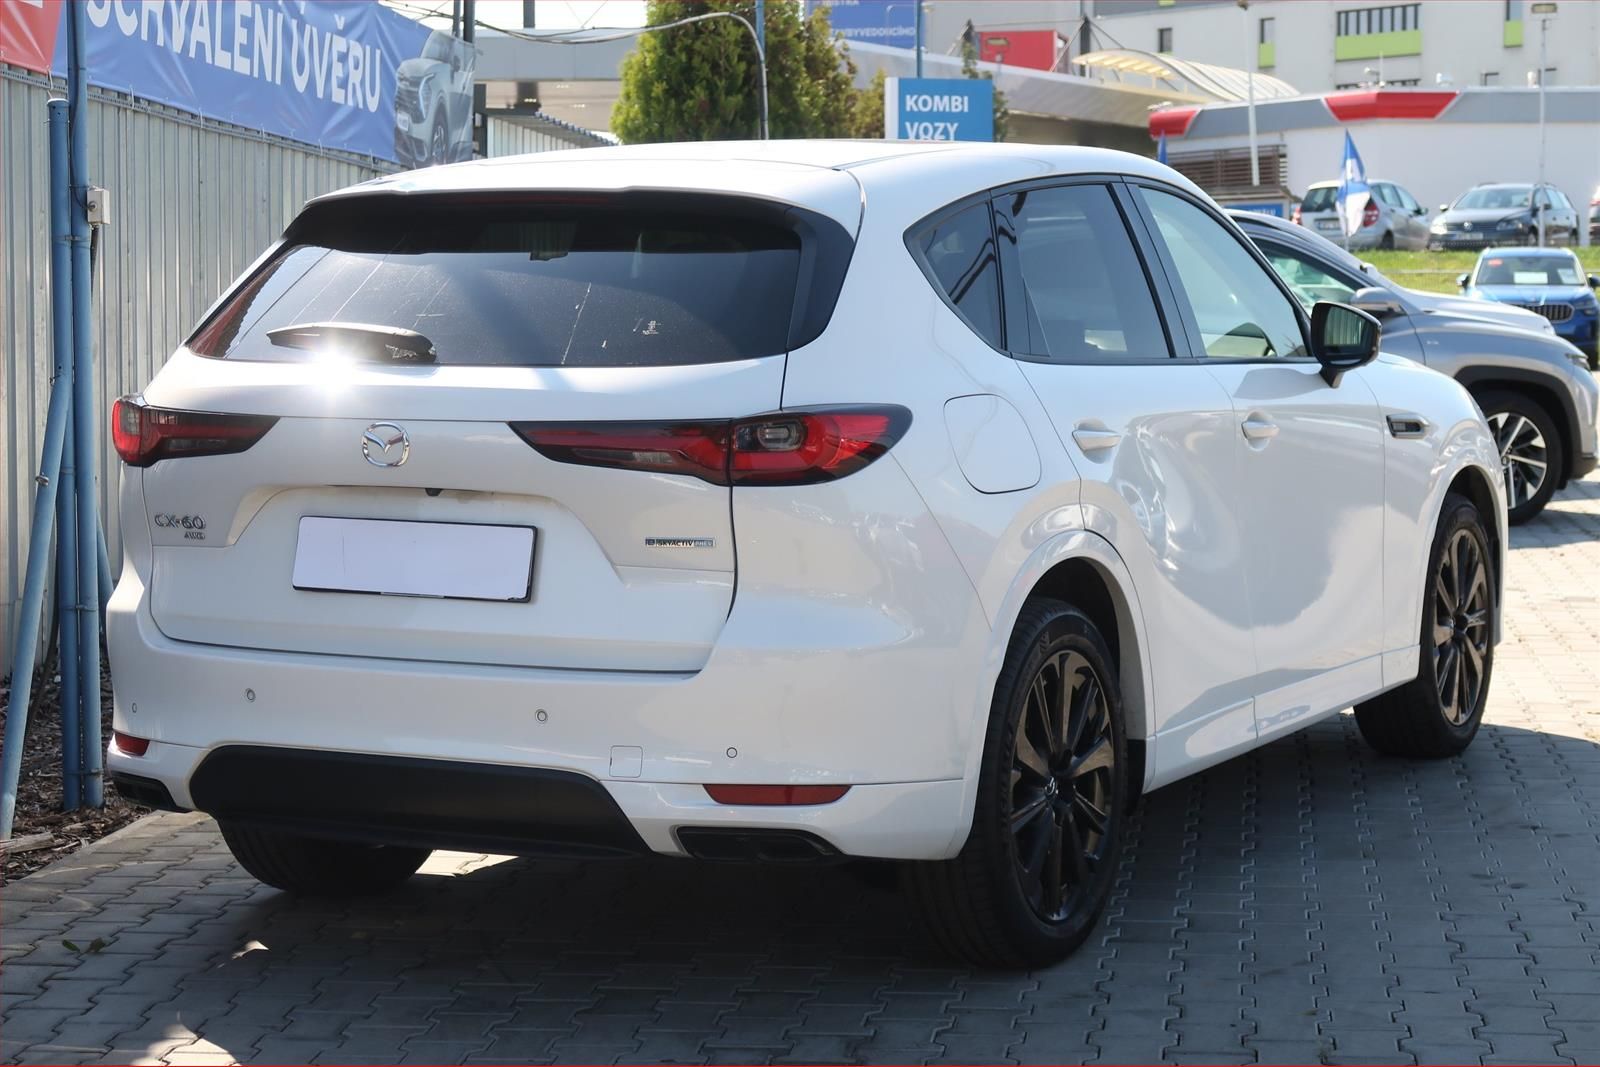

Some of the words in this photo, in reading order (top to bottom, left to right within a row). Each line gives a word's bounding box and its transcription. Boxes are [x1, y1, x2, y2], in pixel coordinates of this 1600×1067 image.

[291, 1, 381, 113] ÚVĚRU
[905, 94, 969, 113] KOMBI
[905, 122, 959, 140] VOZY
[154, 513, 206, 529] CX-60
